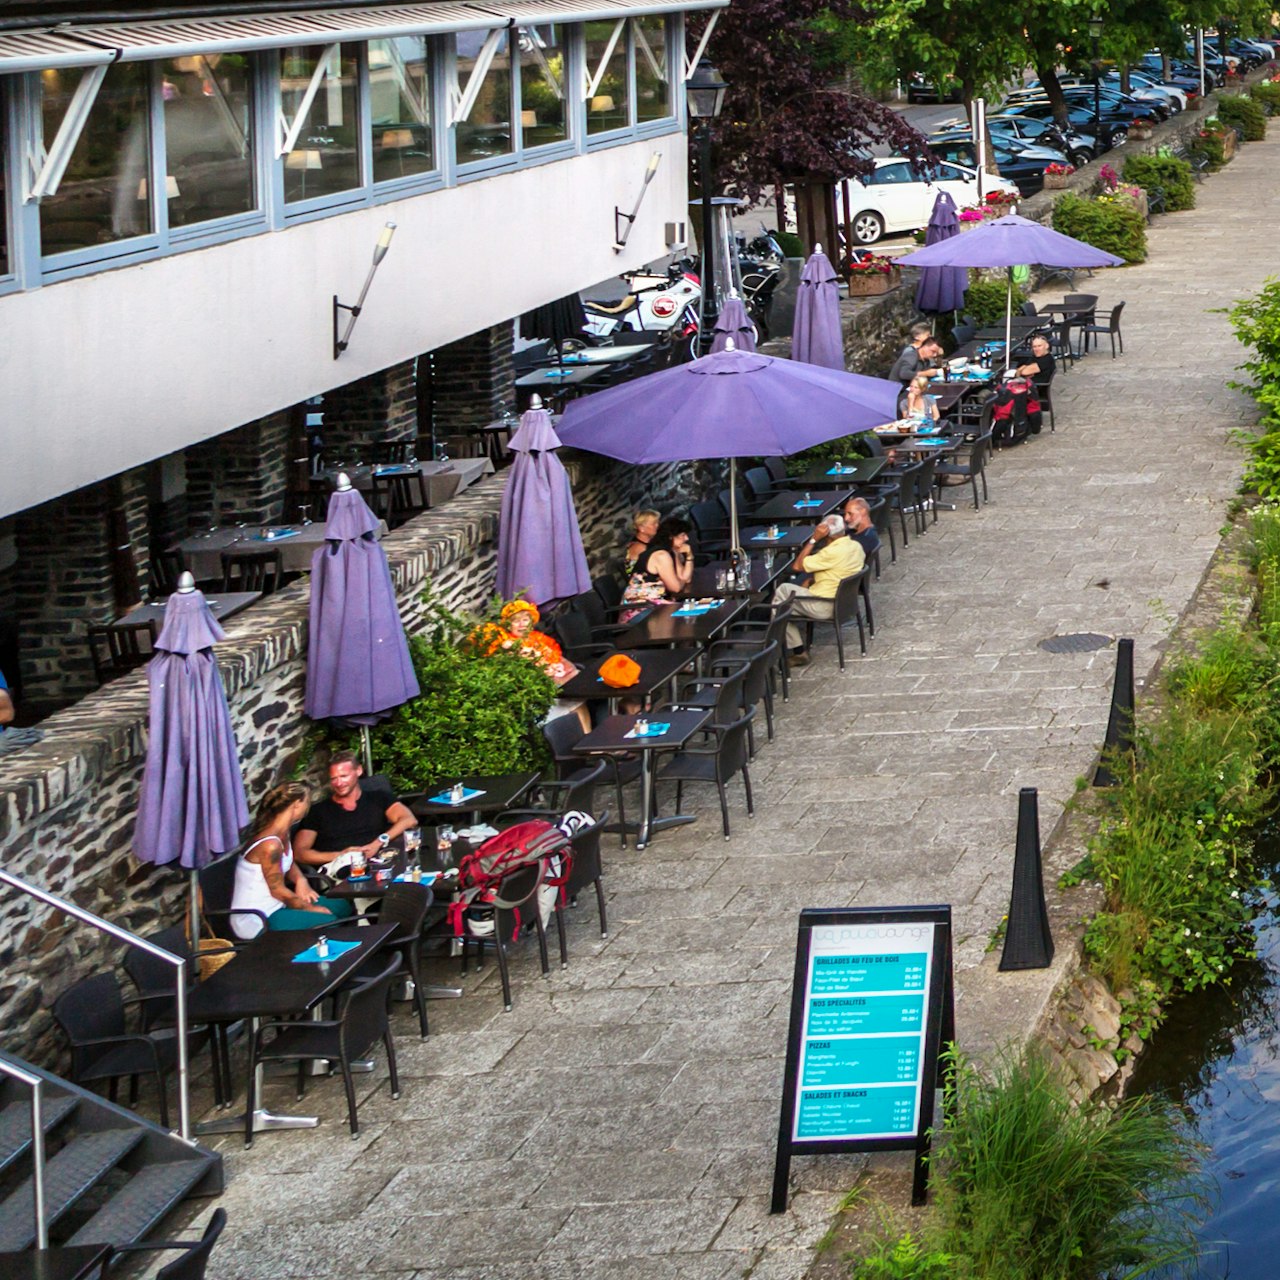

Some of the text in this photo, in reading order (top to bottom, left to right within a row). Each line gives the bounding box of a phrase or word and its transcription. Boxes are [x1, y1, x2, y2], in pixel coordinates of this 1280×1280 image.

[816, 955, 900, 965] GRILLADES AU FEU DE BOIS
[812, 1000, 826, 1008] NOS
[804, 1090, 868, 1100] SALADES ET SNACKS
